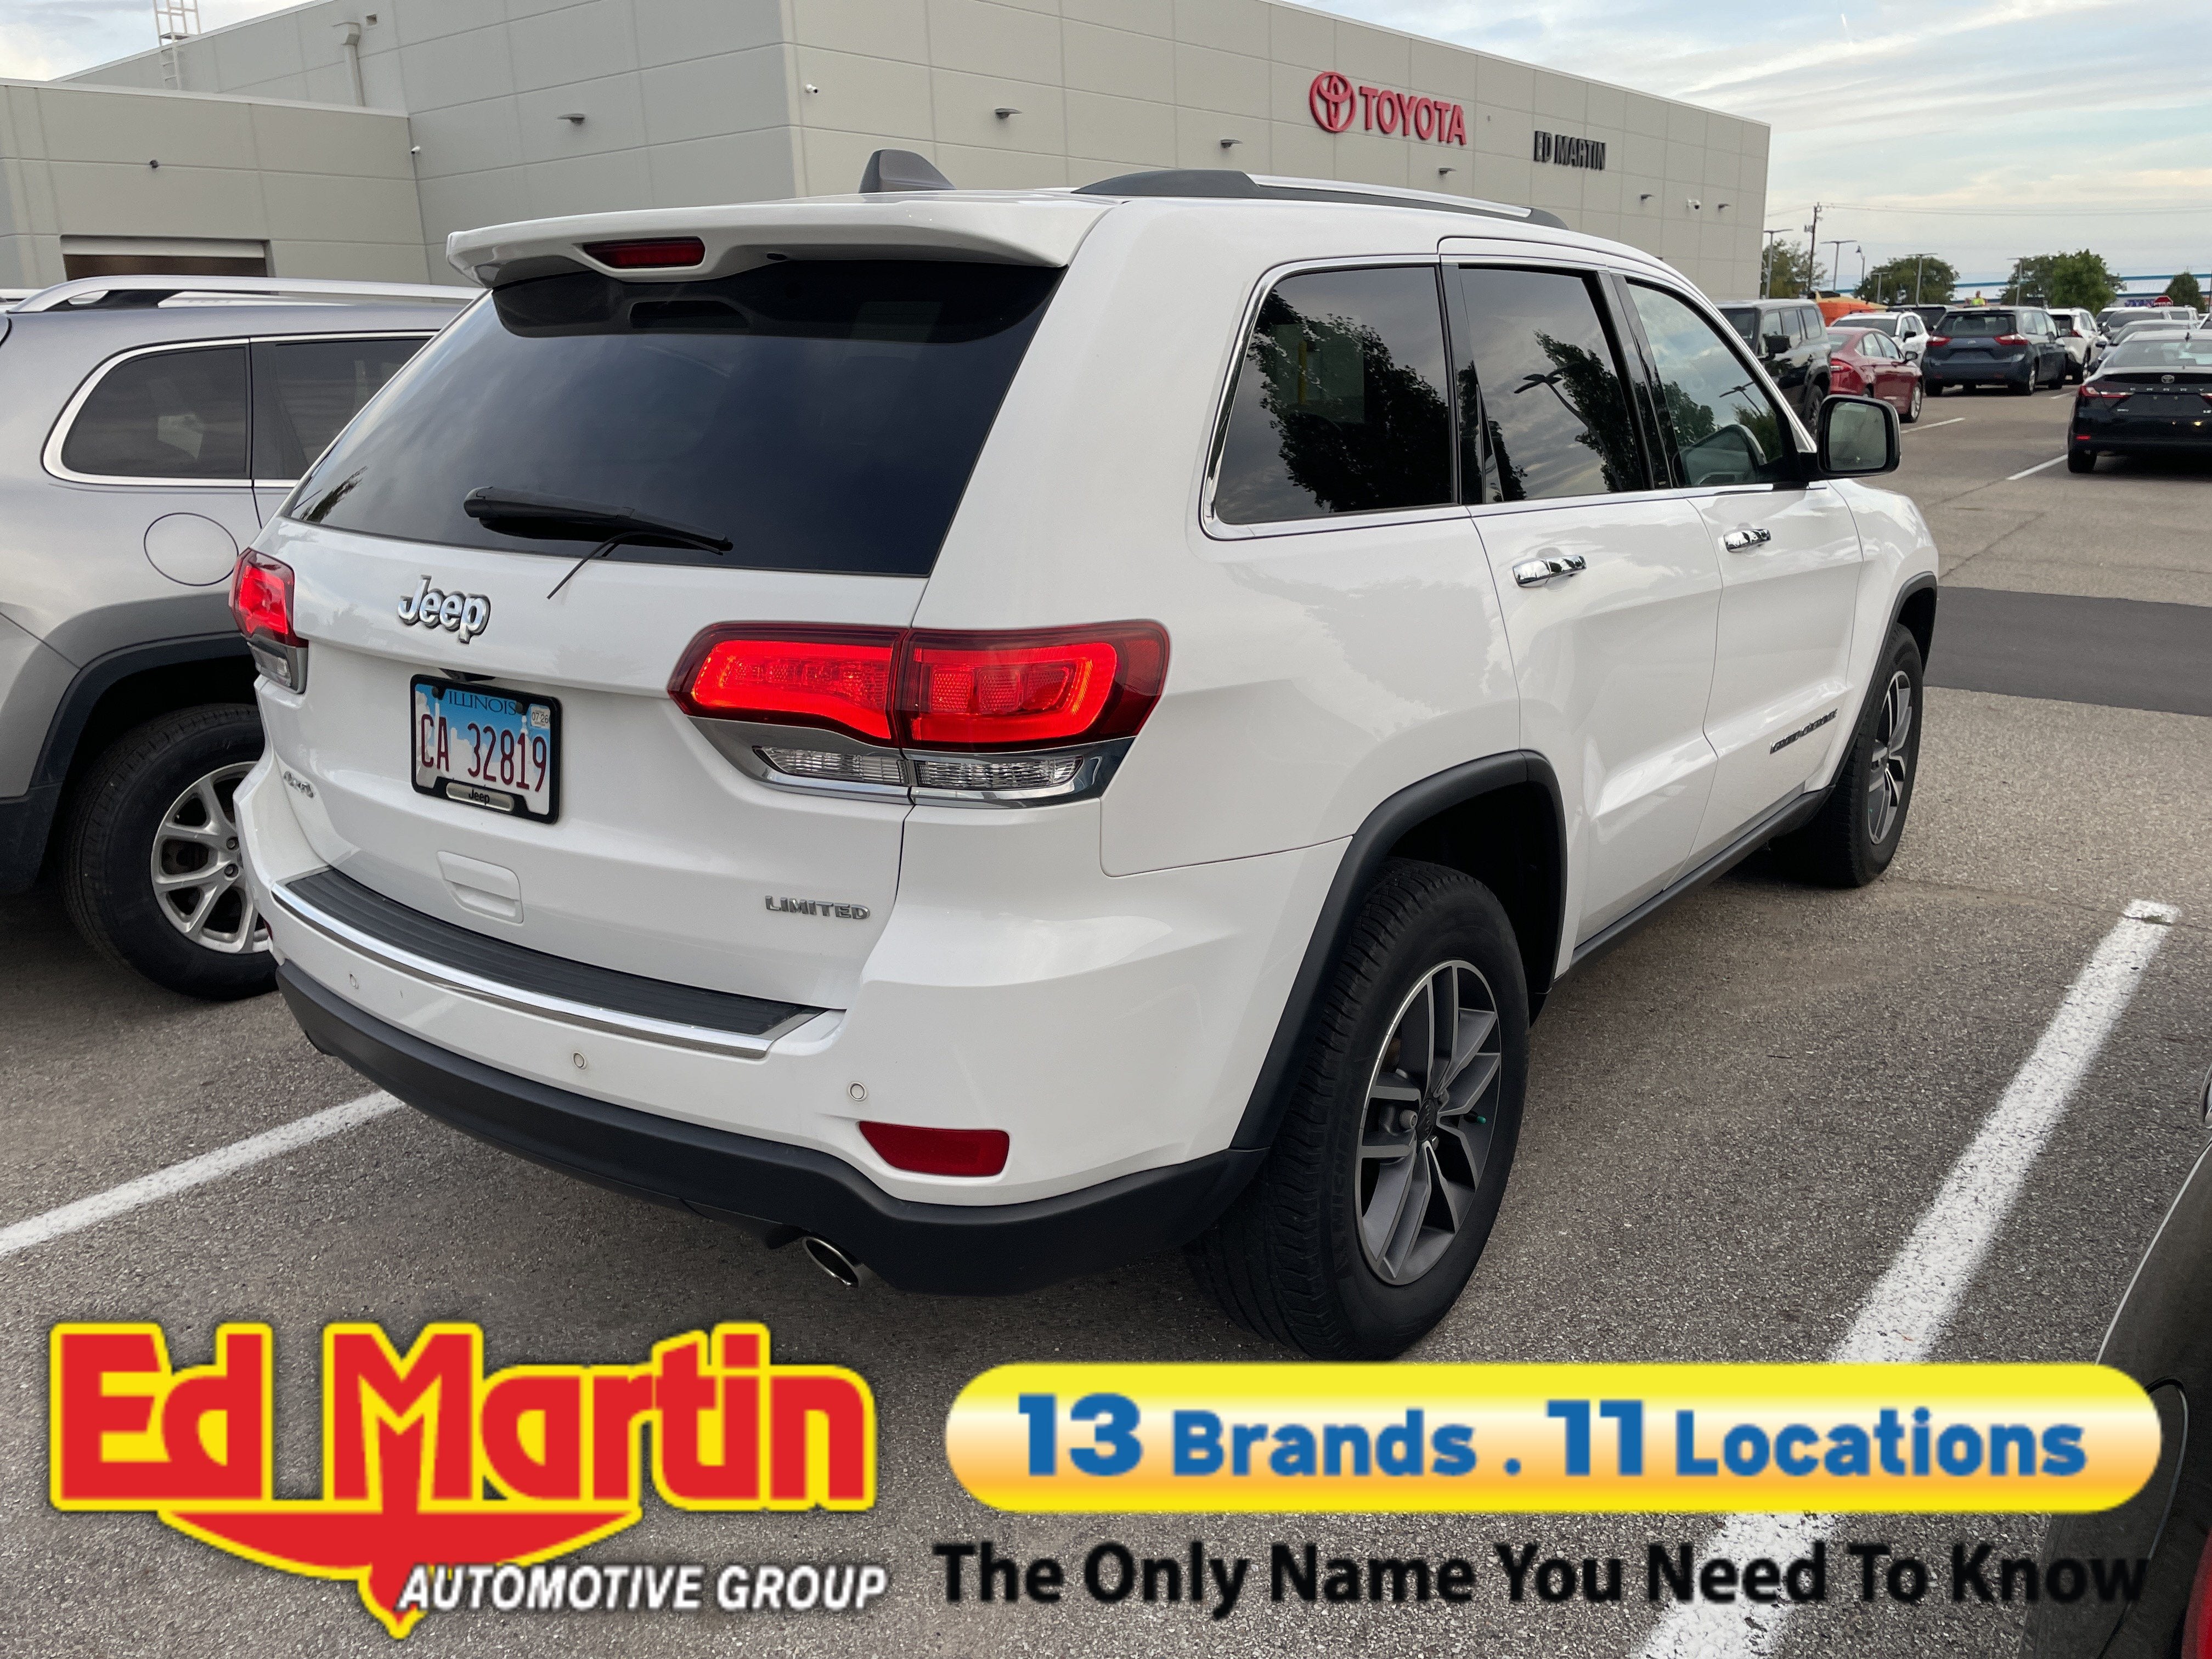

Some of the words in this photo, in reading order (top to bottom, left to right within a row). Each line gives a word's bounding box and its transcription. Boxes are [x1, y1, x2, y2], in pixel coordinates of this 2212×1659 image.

[1359, 86, 1467, 145] TOYOTA
[1534, 131, 1551, 162] ED
[1554, 135, 1605, 170] MARTIN
[398, 574, 491, 644] Jeep
[449, 691, 517, 715] ILLINOIS
[421, 714, 449, 772] CA
[467, 723, 547, 792] 32819
[468, 789, 489, 804] Jeep
[765, 895, 871, 919] LIMITED
